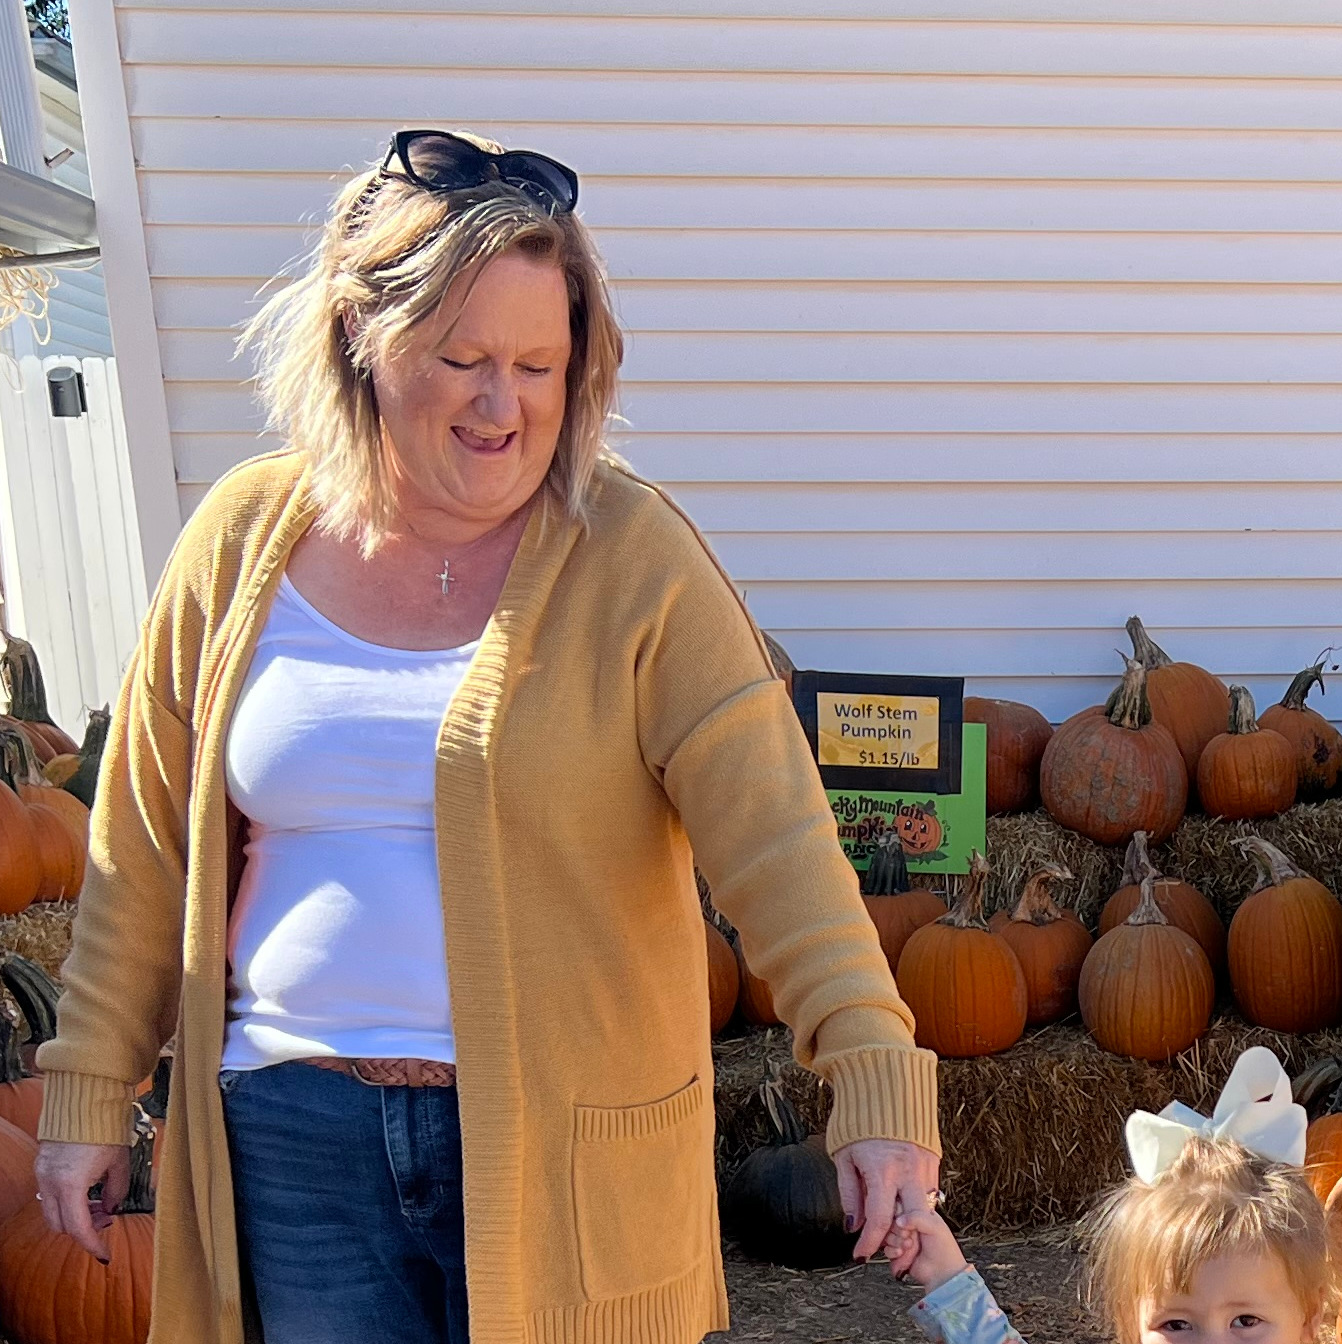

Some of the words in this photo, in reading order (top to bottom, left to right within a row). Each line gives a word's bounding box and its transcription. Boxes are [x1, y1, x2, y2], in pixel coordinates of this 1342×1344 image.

[834, 703, 873, 719] Wolf
[876, 705, 918, 721] Stem
[841, 723, 912, 742] Pumpkin
[858, 750, 920, 768] $1.15/lb
